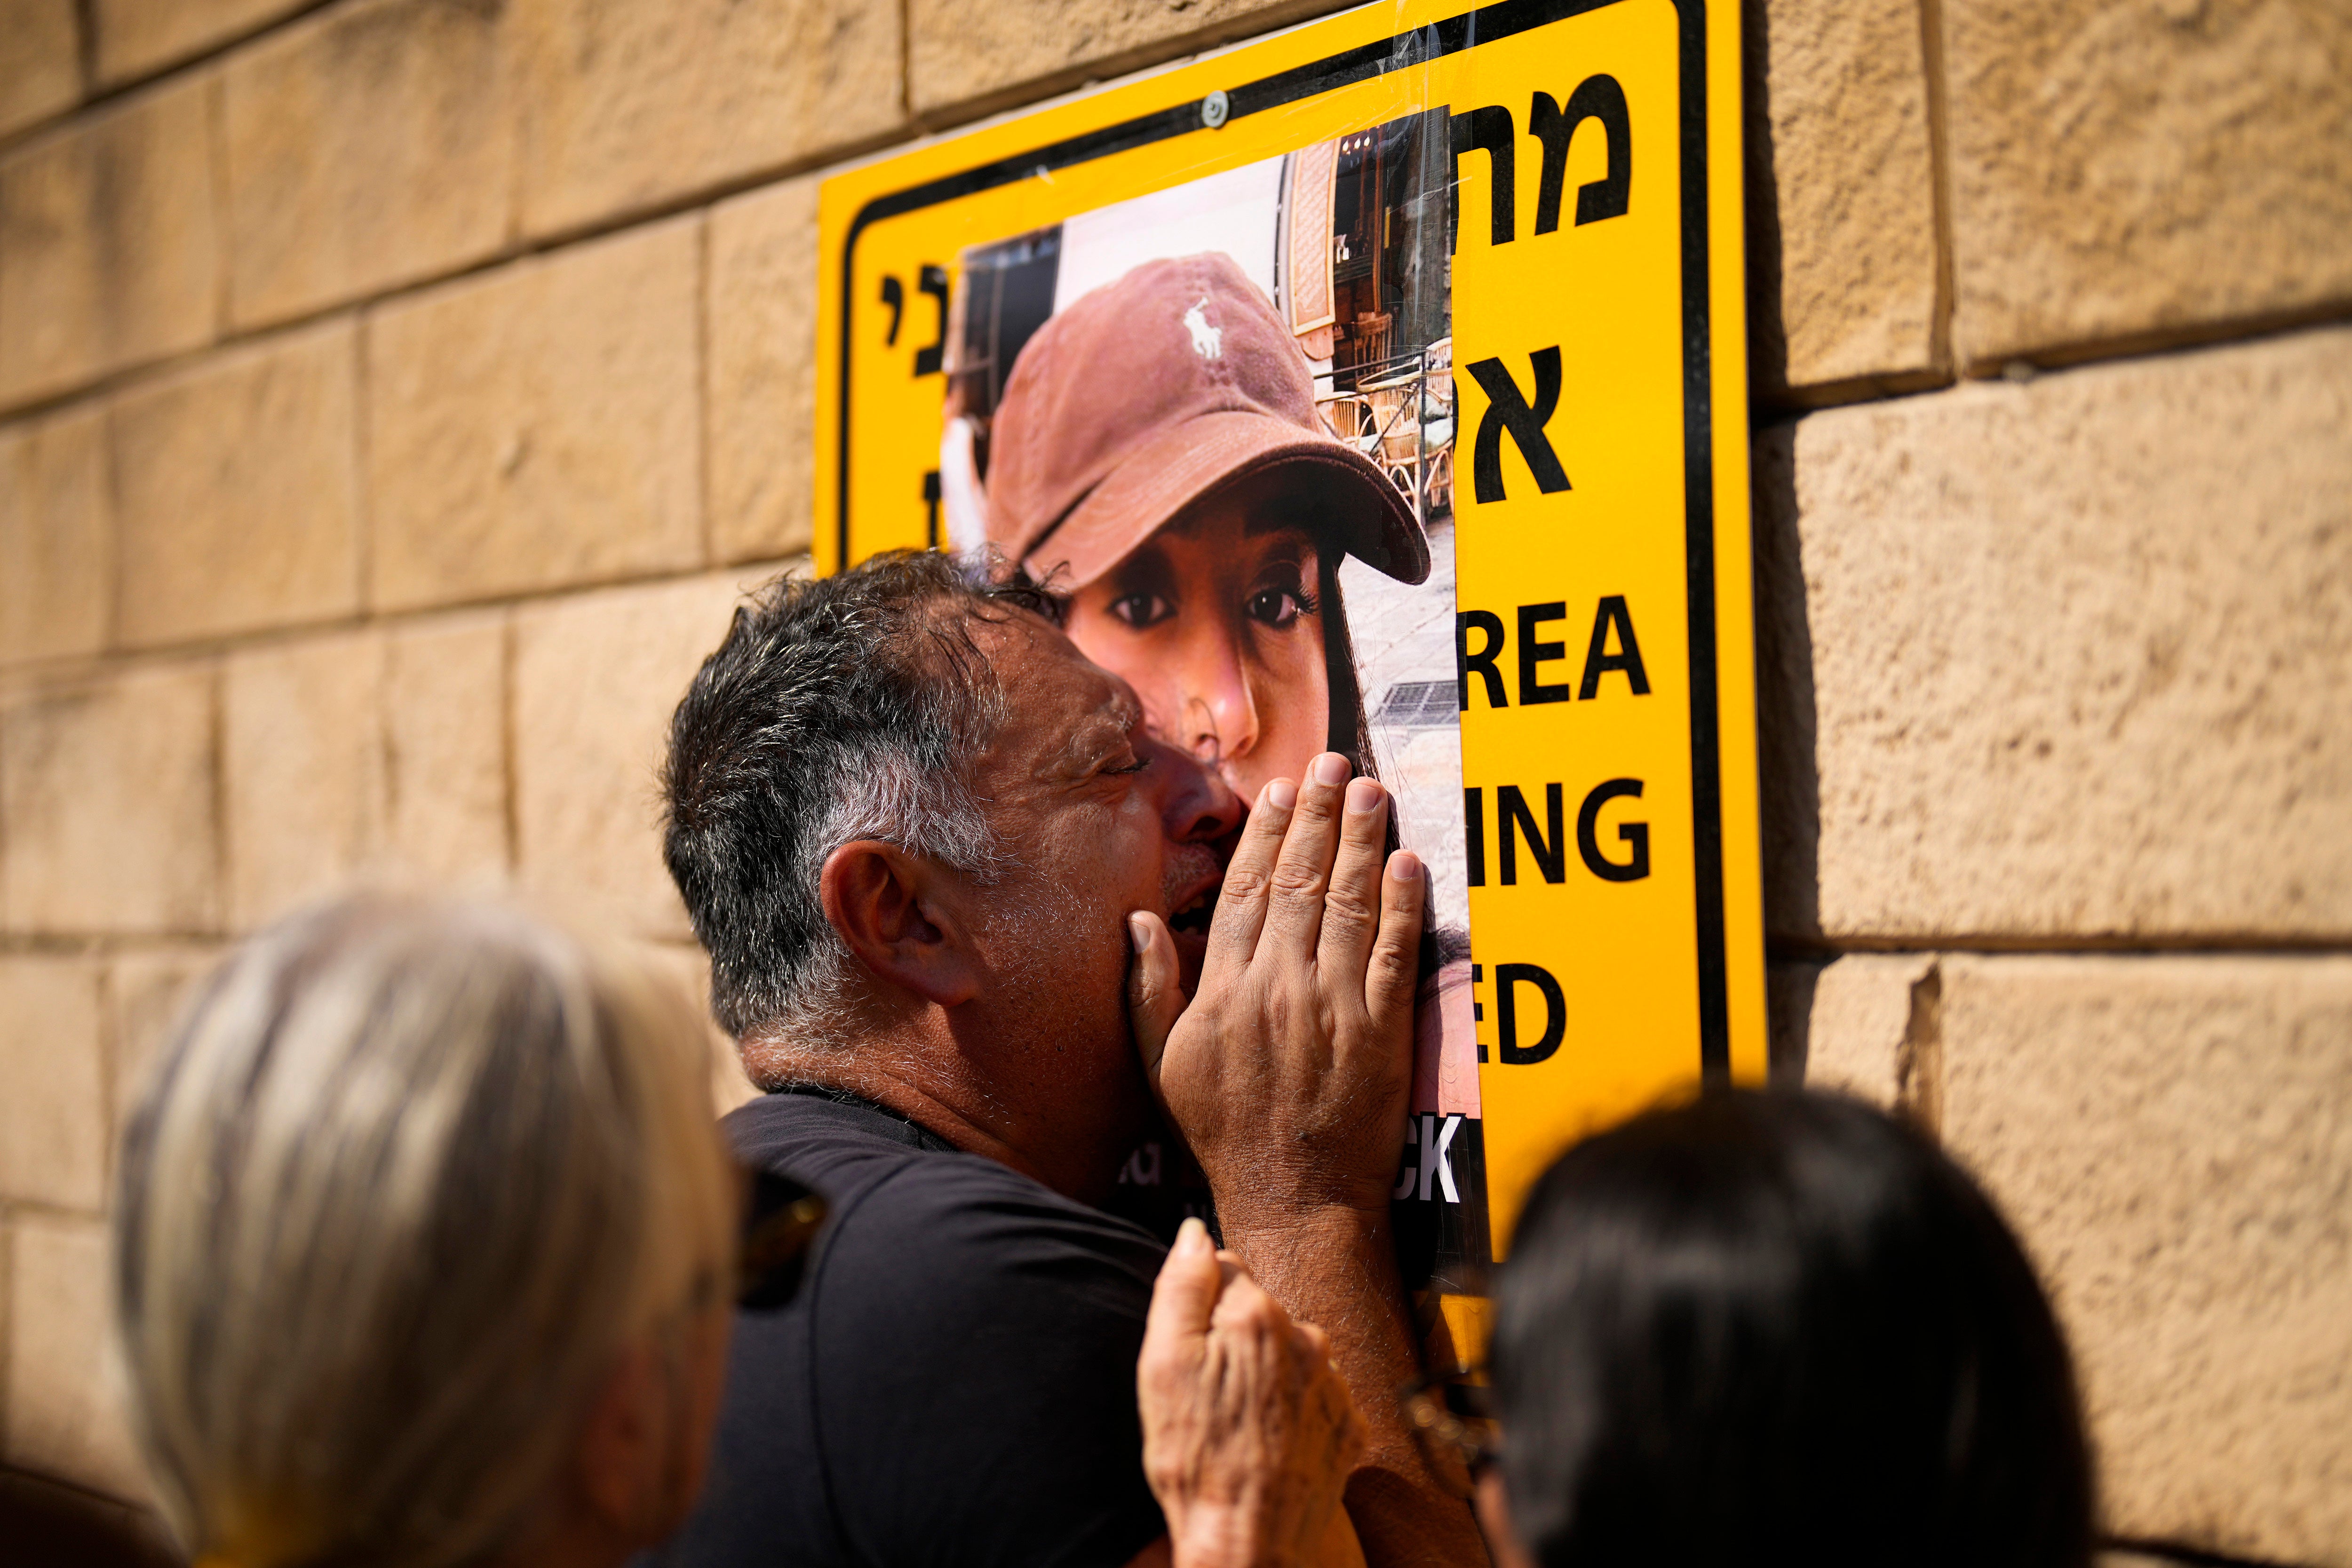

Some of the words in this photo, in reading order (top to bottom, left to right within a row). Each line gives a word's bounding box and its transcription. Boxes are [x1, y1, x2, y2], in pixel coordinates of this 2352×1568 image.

[1452, 345, 1572, 504] א
[1456, 594, 1651, 711] REA
[1464, 778, 1651, 887] ING
[1472, 962, 1567, 1066] D
